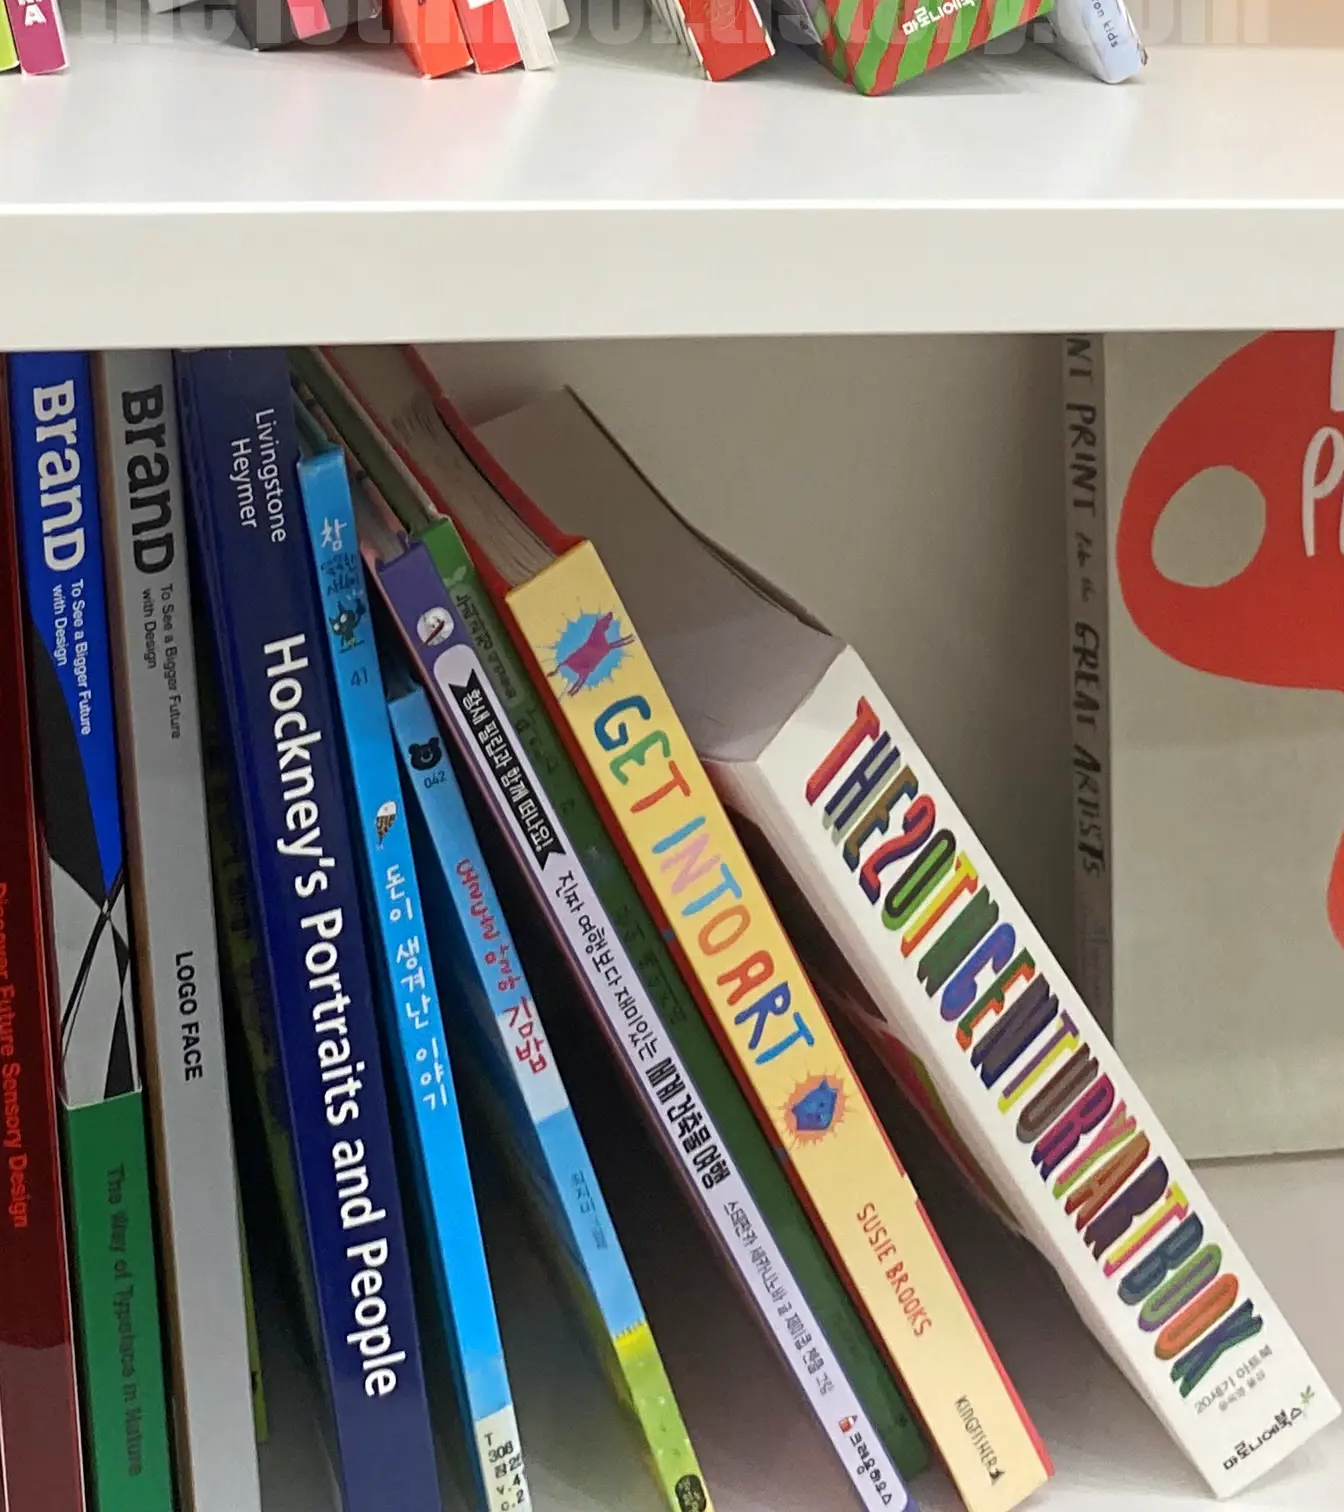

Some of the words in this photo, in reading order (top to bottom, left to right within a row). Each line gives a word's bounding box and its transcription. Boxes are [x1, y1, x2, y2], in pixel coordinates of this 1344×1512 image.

[229, 438, 258, 530] Heymer
[254, 407, 287, 544] Livingstone
[263, 634, 337, 899] Hockney's
[593, 695, 692, 815] GET
[652, 815, 752, 956] INTO
[717, 947, 815, 1066] ART
[175, 950, 198, 1016] LOGO
[181, 1021, 204, 1082] FACE
[299, 910, 365, 1128] Portraits
[333, 1142, 386, 1231] and
[645, 1057, 686, 1105] 세계
[666, 1094, 712, 1154] 건축물
[692, 1144, 731, 1190] 여행
[346, 1238, 406, 1398] People
[855, 1202, 896, 1264] SUSIE
[884, 1261, 933, 1339] BROOKS
